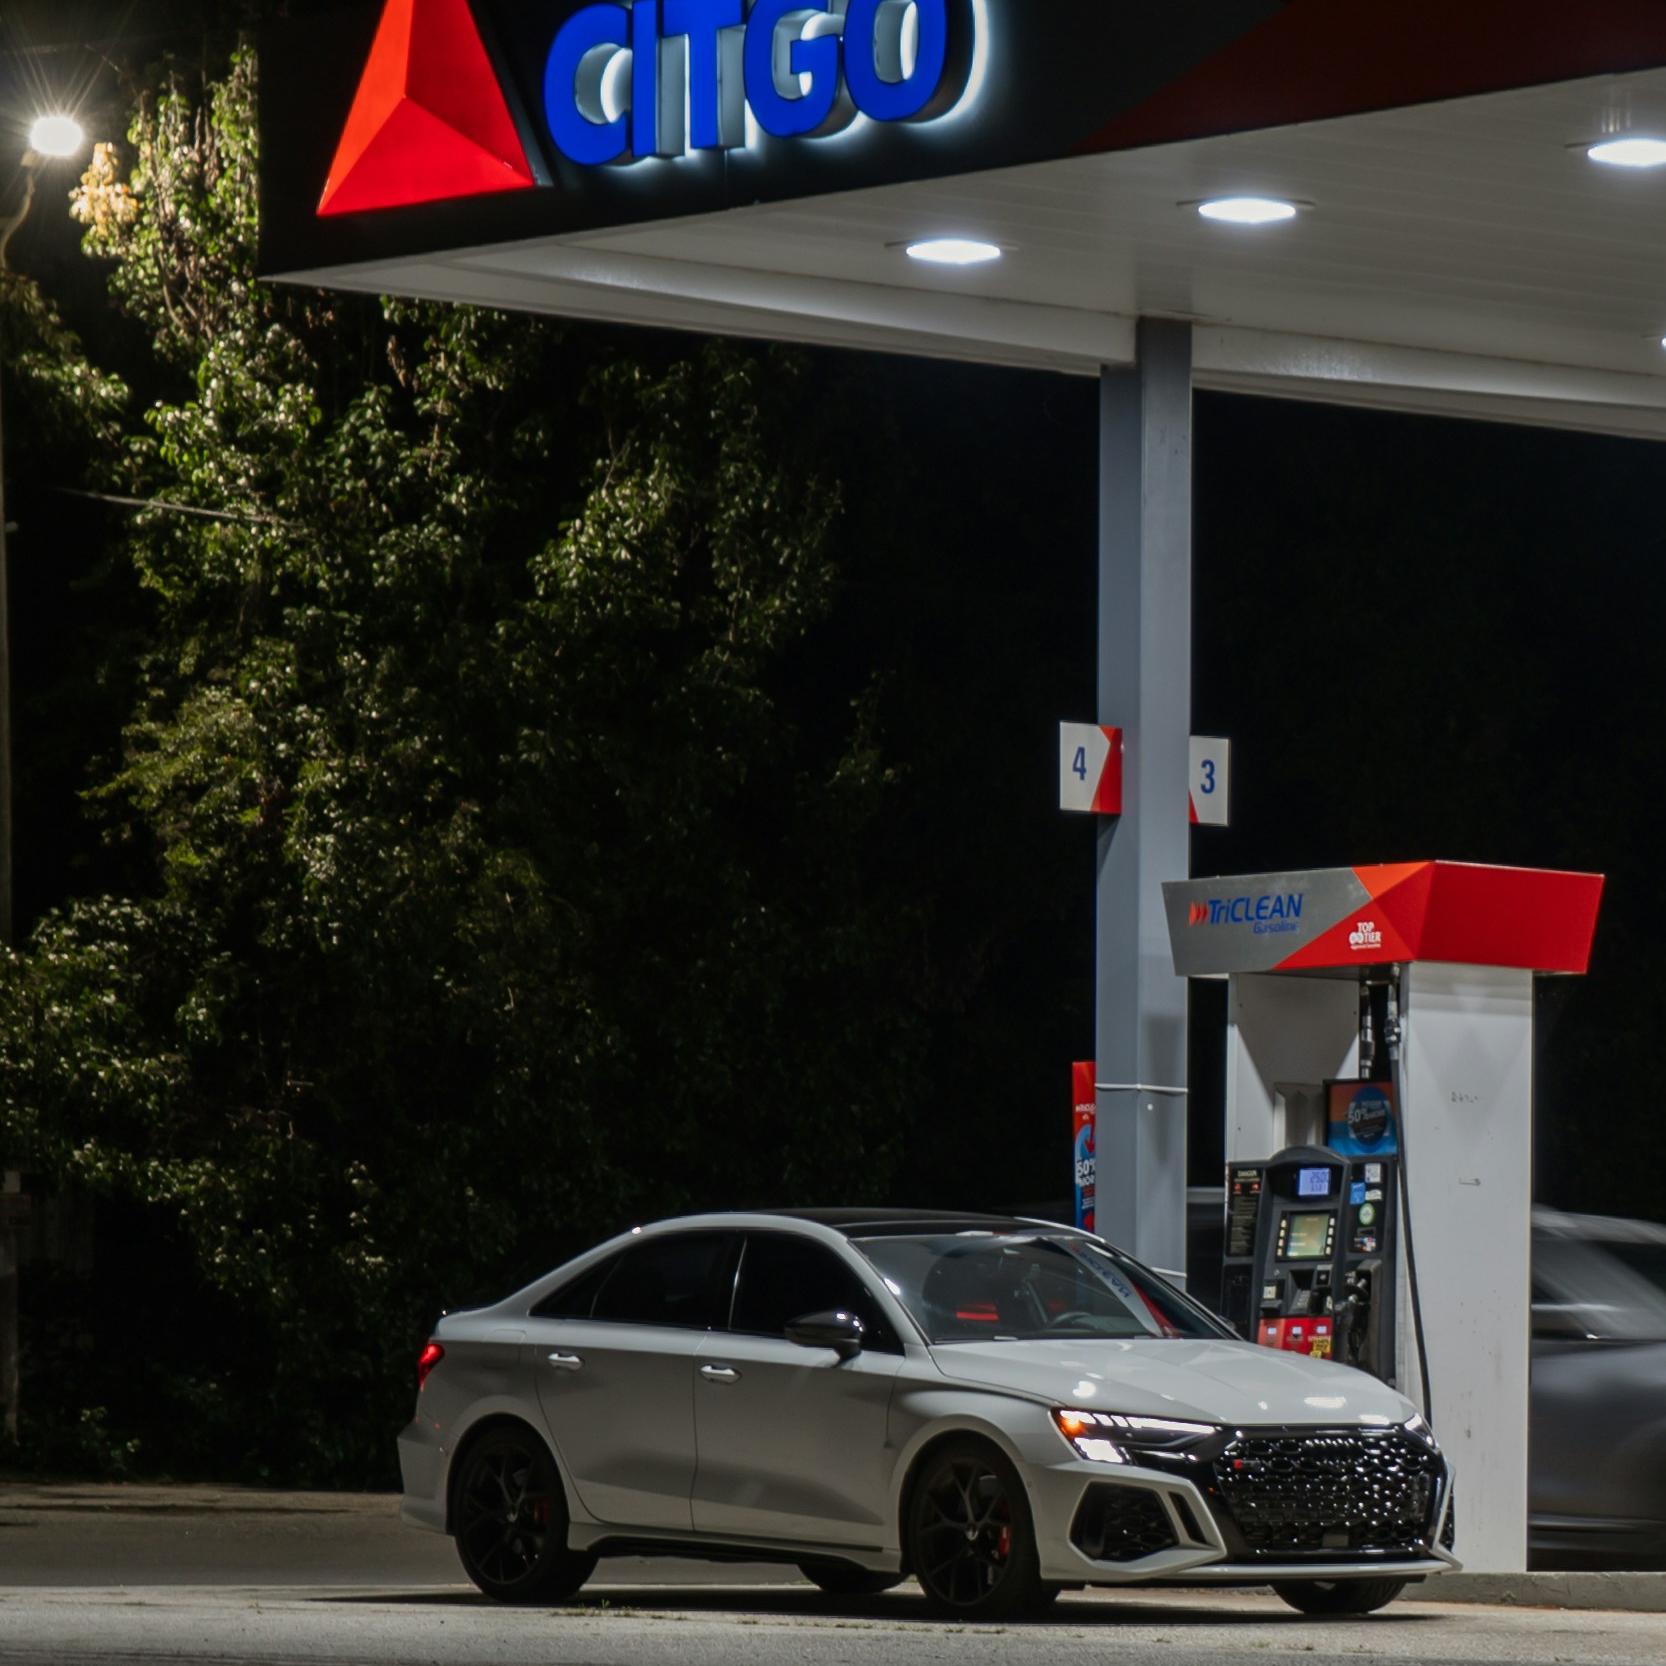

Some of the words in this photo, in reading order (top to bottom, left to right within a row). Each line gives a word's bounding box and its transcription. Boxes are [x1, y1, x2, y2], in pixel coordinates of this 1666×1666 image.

[1072, 746, 1087, 781] 4
[1200, 759, 1215, 794] 3
[1208, 893, 1303, 924] TriCLEAN
[1253, 920, 1299, 934] Gasoline
[1356, 921, 1375, 933] TOP
